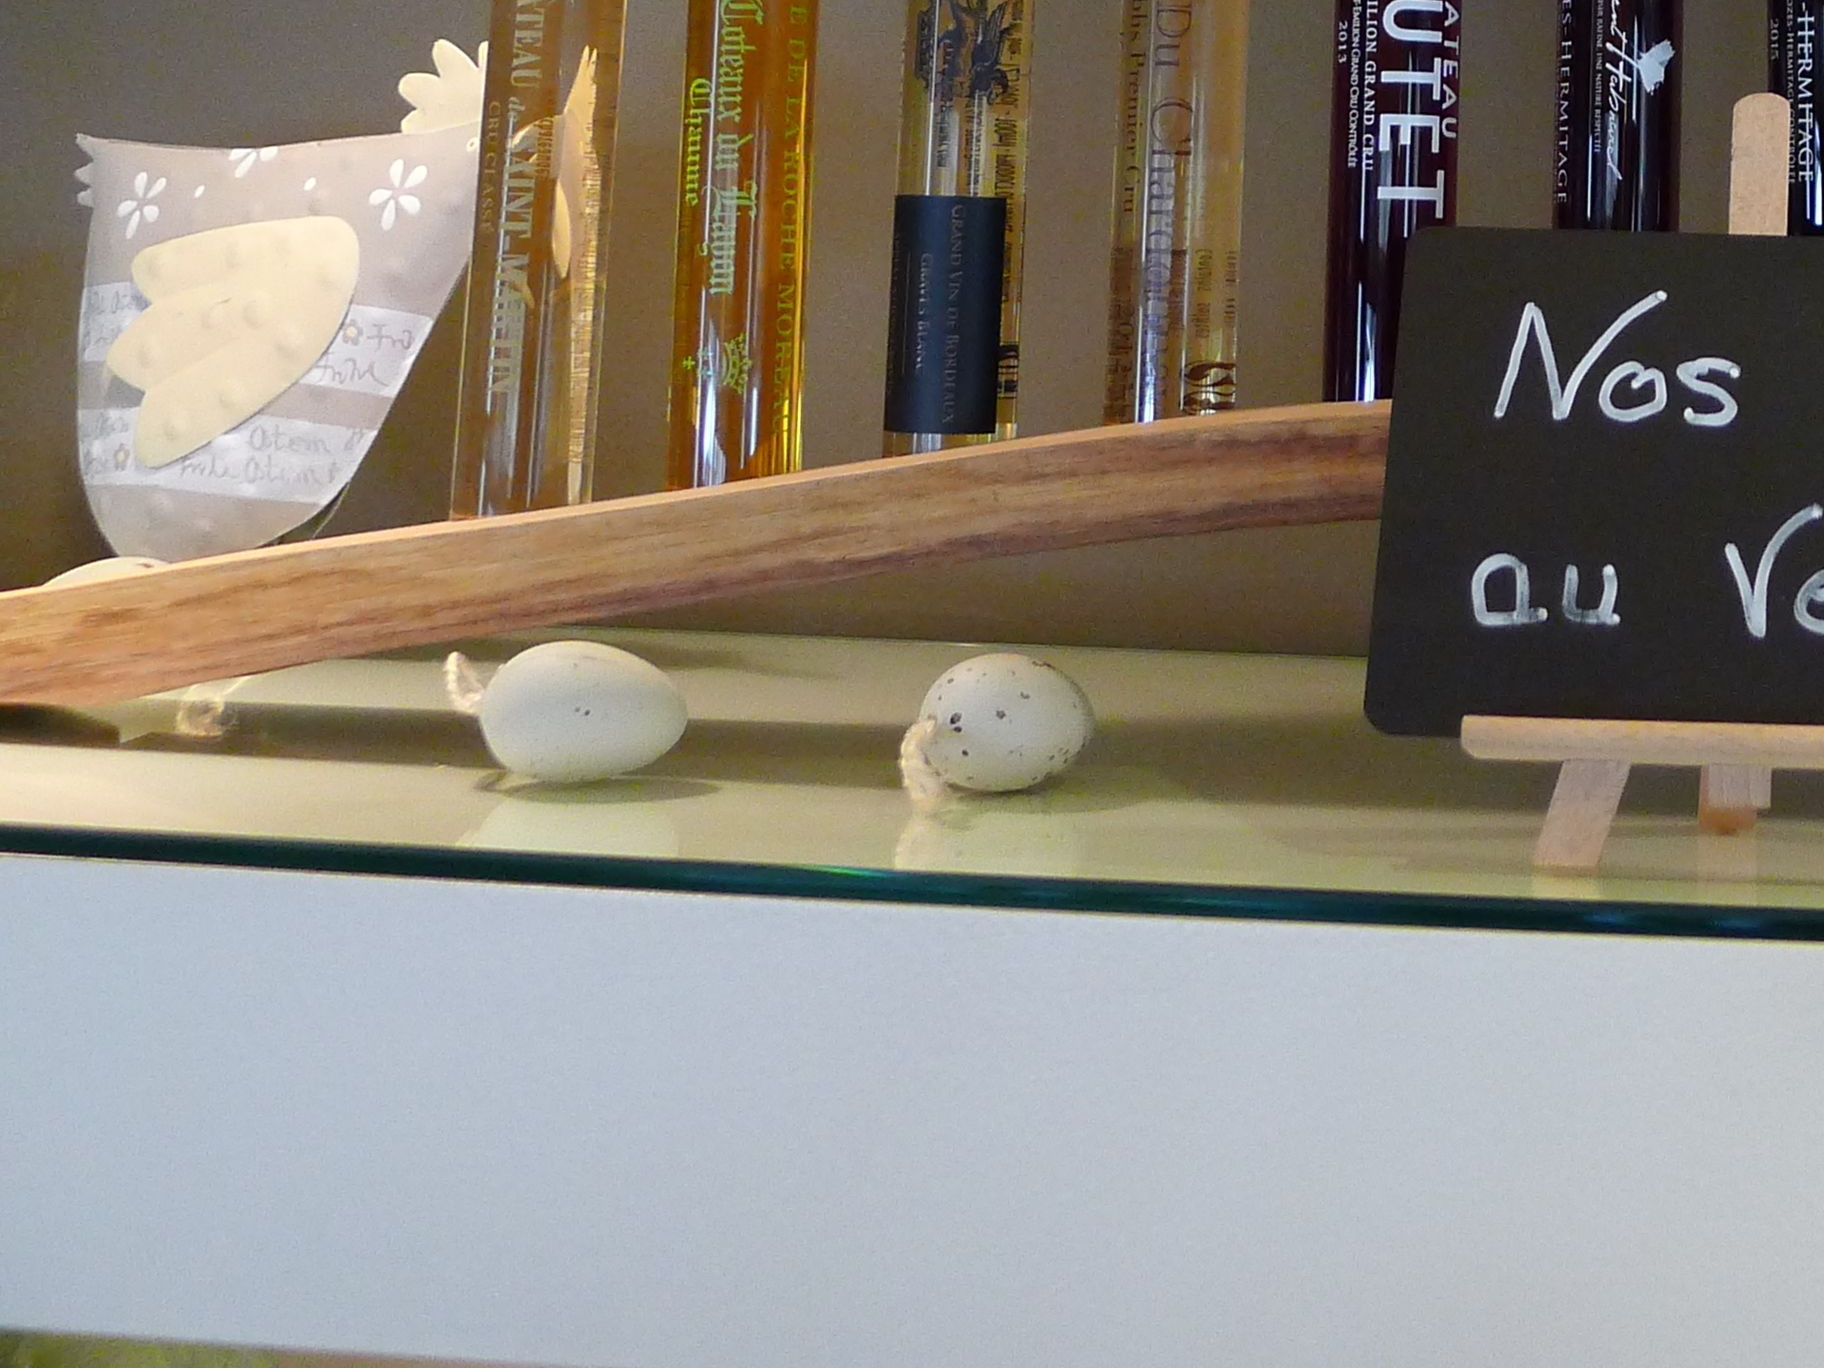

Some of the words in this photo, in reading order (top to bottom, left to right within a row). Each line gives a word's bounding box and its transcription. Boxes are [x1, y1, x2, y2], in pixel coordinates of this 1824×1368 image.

[787, 38, 805, 83] DE
[1154, 0, 1194, 69] Du
[1337, 20, 1349, 64] 2013
[1770, 18, 1781, 61] 2015
[1348, 86, 1360, 109] CRU
[1349, 49, 1361, 86] GRAND
[1362, 60, 1377, 126] GRAND
[783, 95, 802, 140] LA
[1124, 51, 1147, 156] Premier
[685, 78, 713, 208] Chaume
[1361, 133, 1375, 171] CRU
[778, 152, 802, 271] ROCHE
[1123, 165, 1142, 214] Cru
[698, 180, 758, 295] Layon
[949, 204, 966, 266] GRAND
[941, 335, 961, 425] BORDEAUX
[1494, 290, 1742, 428] Nos
[1470, 552, 1621, 627] au
